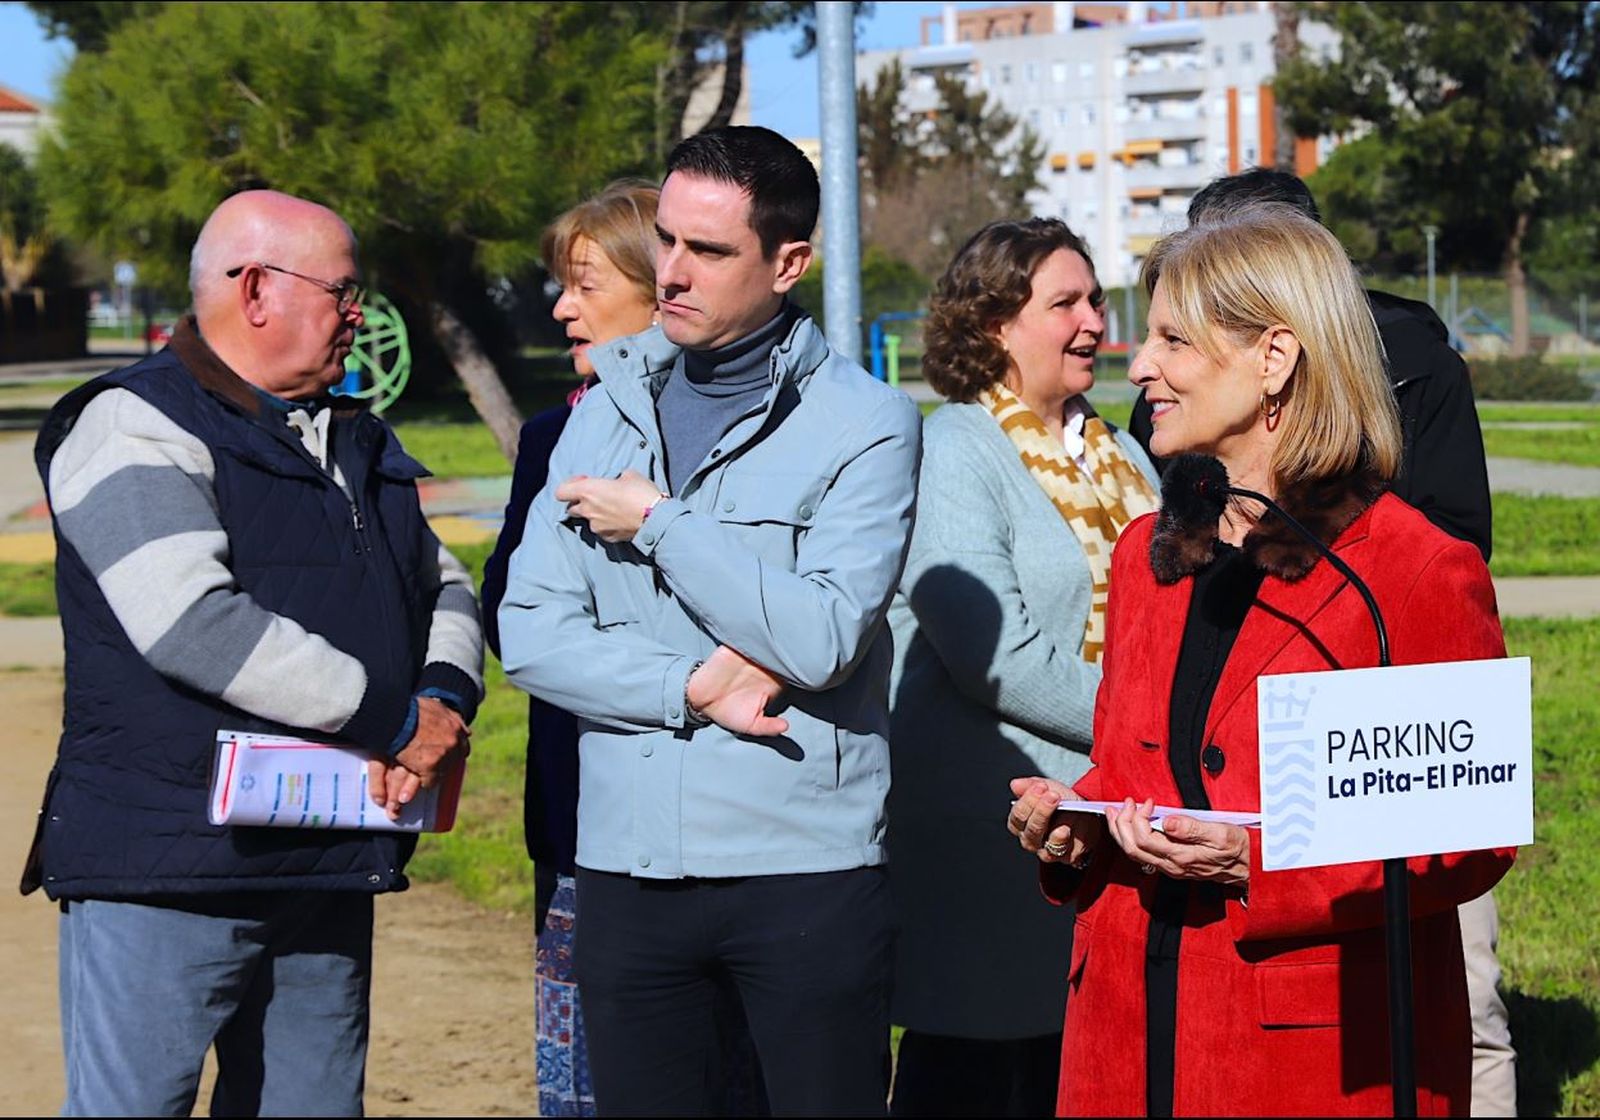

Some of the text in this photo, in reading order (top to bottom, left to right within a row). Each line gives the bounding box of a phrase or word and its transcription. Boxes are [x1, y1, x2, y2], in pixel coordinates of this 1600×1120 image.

[1327, 719, 1474, 764] PARKING
[1328, 760, 1517, 799] La Pita-El Pinar
